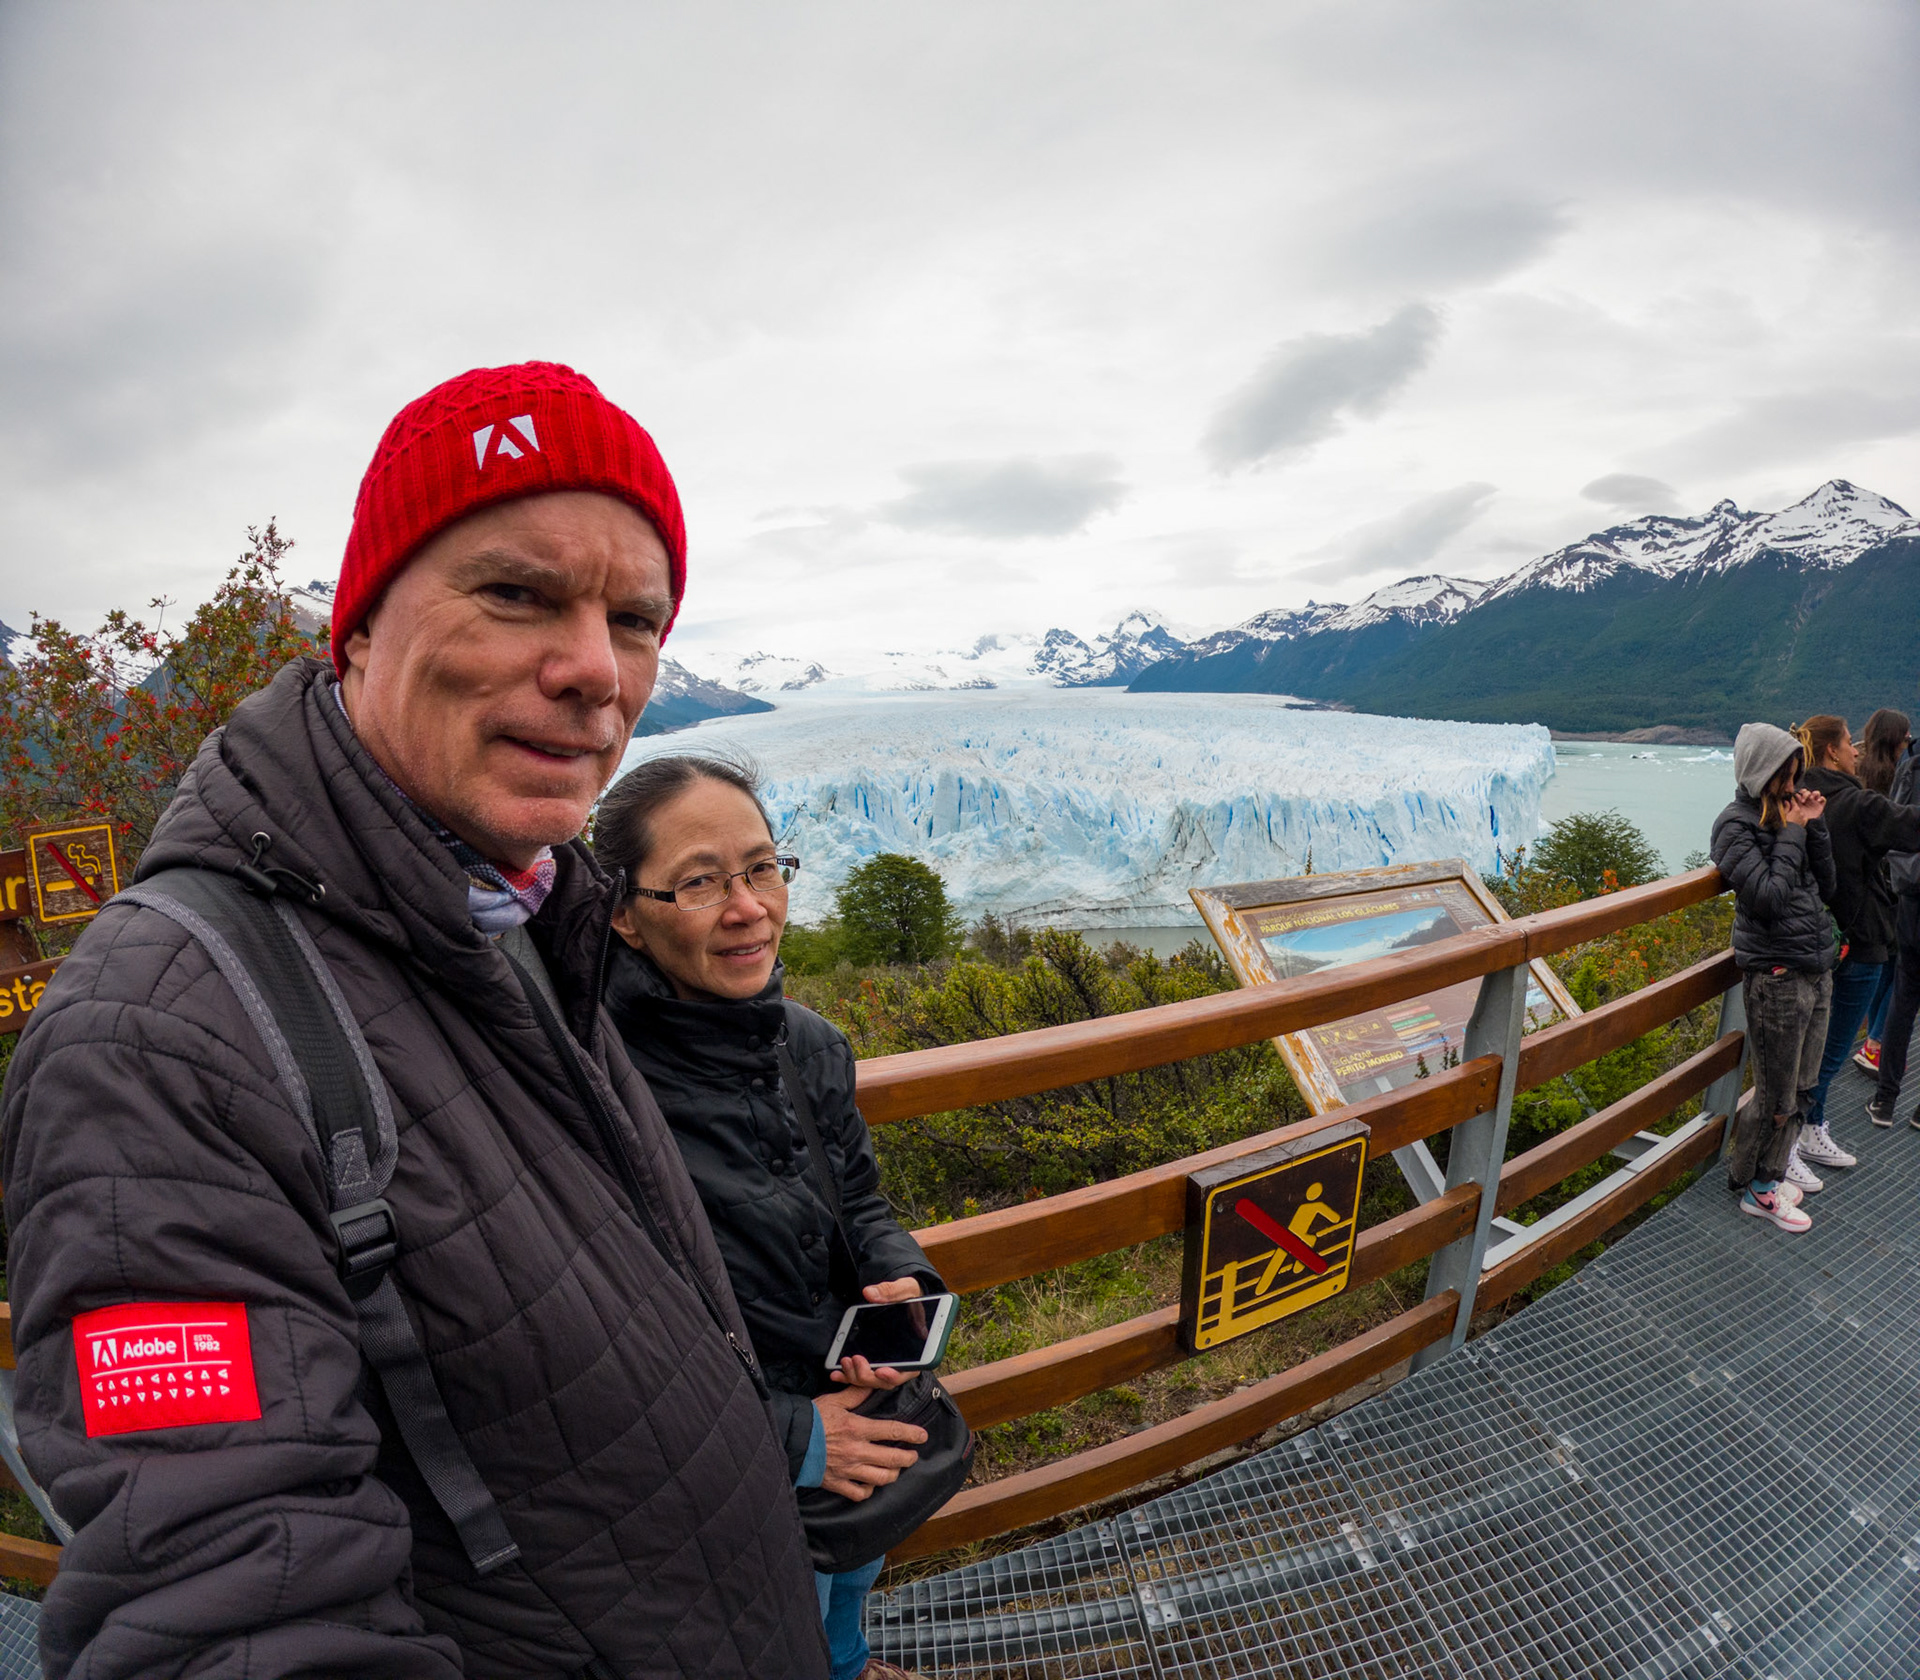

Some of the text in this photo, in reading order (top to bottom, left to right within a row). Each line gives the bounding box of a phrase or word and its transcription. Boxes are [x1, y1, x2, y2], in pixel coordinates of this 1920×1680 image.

[0, 876, 26, 911] r
[1260, 922, 1292, 934] PARQUE
[1294, 912, 1338, 927] NACIONAL
[1336, 910, 1355, 920] LOS
[1354, 902, 1400, 916] GLACIARES
[0, 968, 56, 1017] sta
[1335, 1050, 1404, 1077] PERITO MORENO
[1339, 1050, 1374, 1065] GLACIAR
[122, 1337, 177, 1360] Adobe
[193, 1341, 220, 1352] 1982
